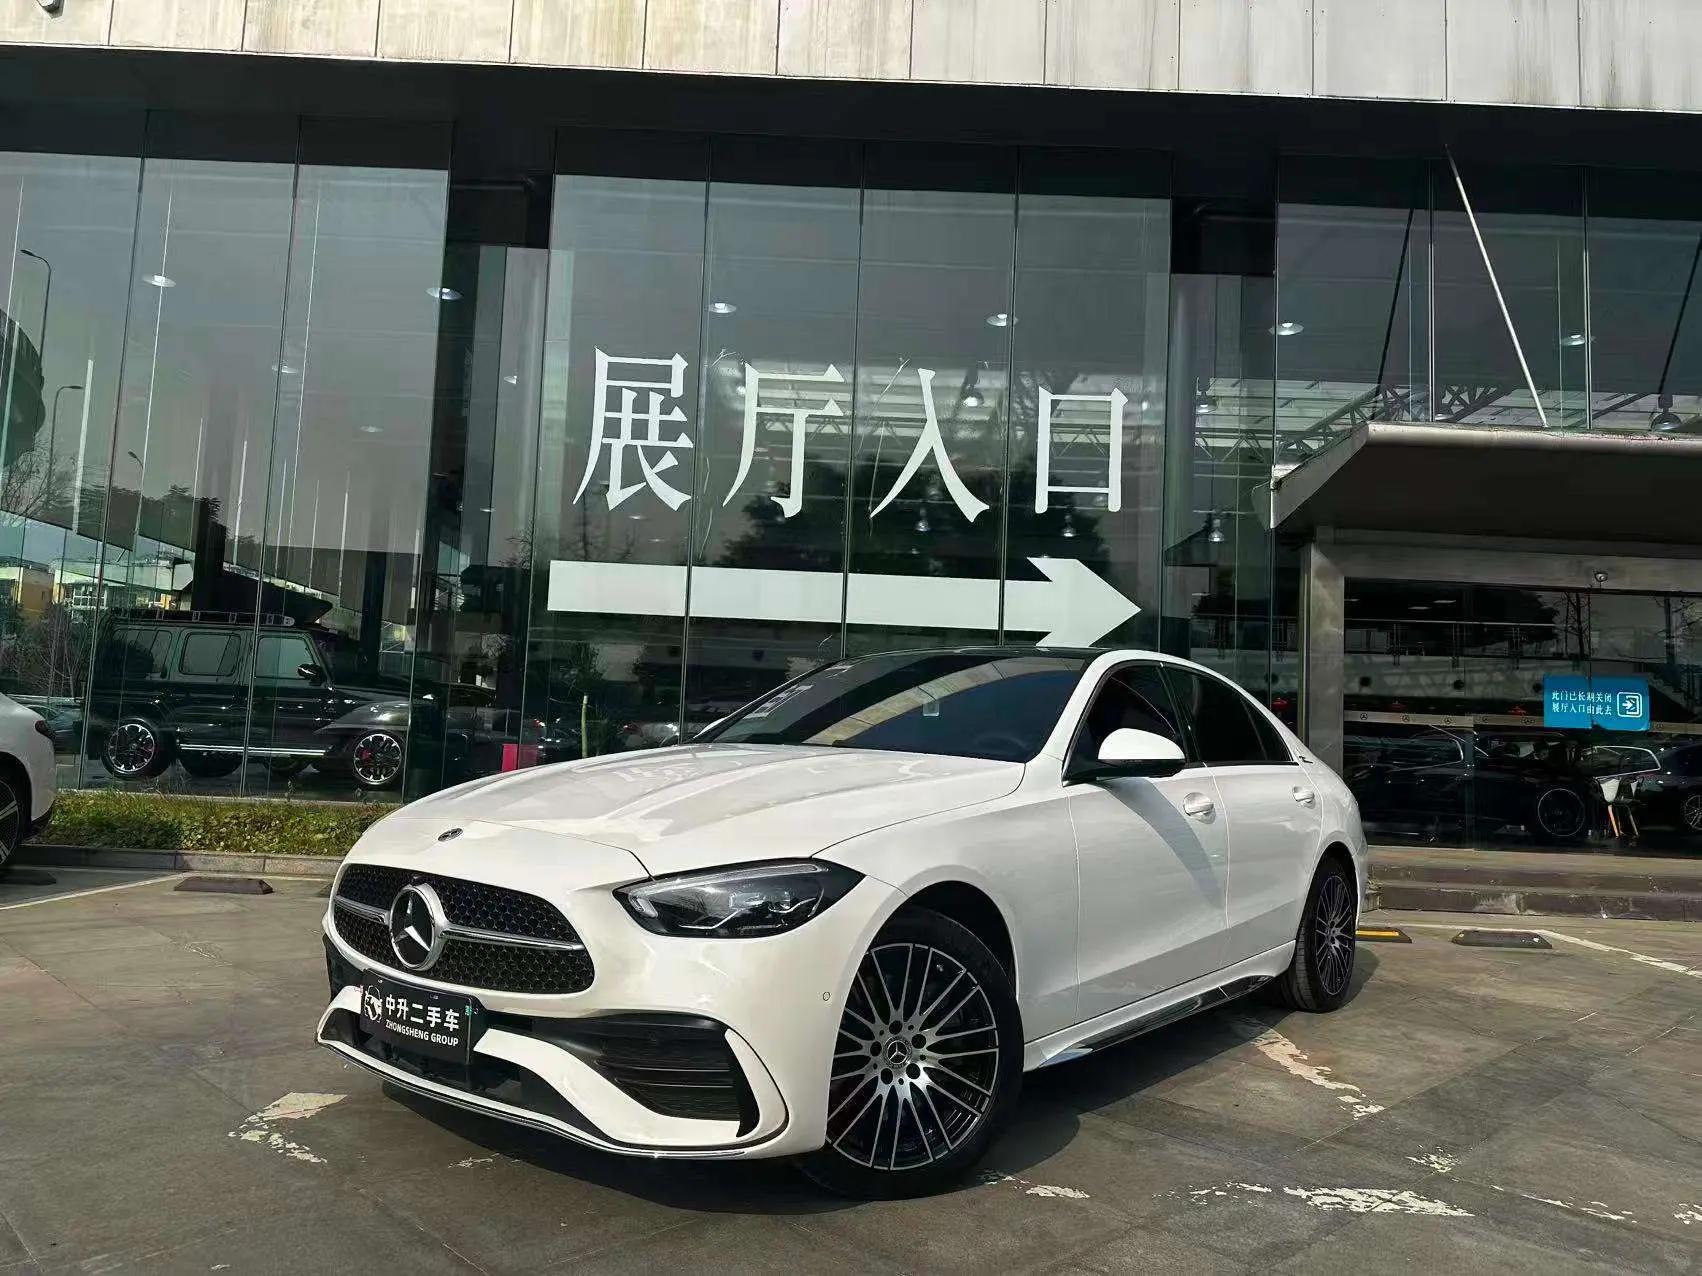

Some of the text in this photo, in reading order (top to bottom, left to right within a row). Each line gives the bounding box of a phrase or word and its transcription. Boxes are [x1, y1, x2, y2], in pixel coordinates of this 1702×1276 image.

[573, 346, 1129, 523] 展厅入口
[385, 994, 460, 1032] 中升二手车
[385, 1019, 459, 1047] ZHONGSHENG GROUP
